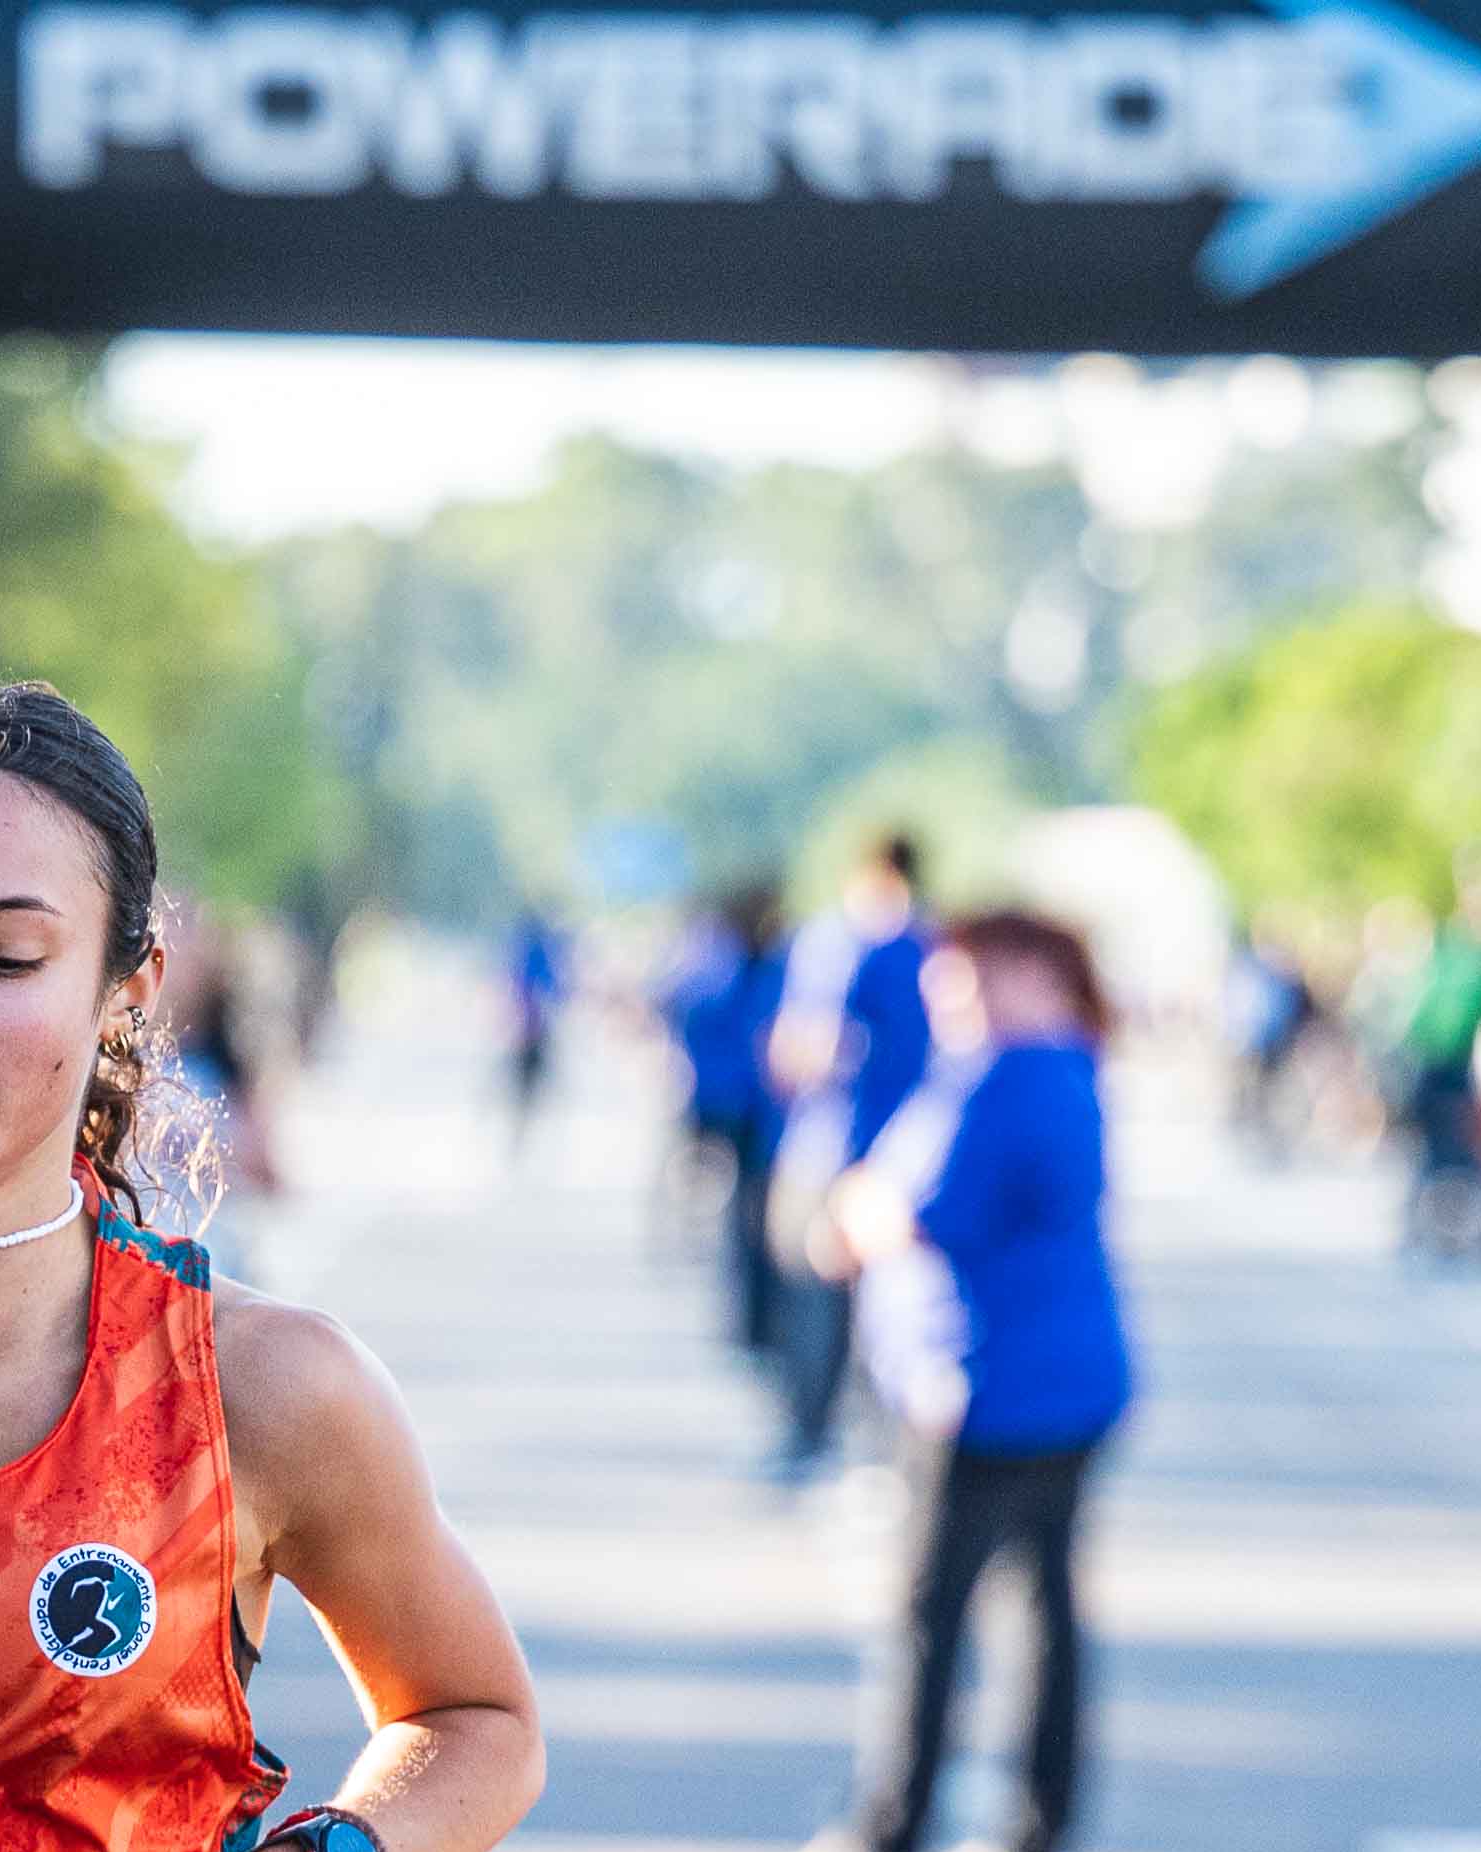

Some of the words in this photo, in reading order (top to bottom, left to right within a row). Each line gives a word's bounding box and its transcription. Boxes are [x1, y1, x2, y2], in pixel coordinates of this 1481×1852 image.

[12, 4, 1368, 200] POWERADE
[39, 1571, 57, 1592] de
[36, 1597, 62, 1652] Grupo
